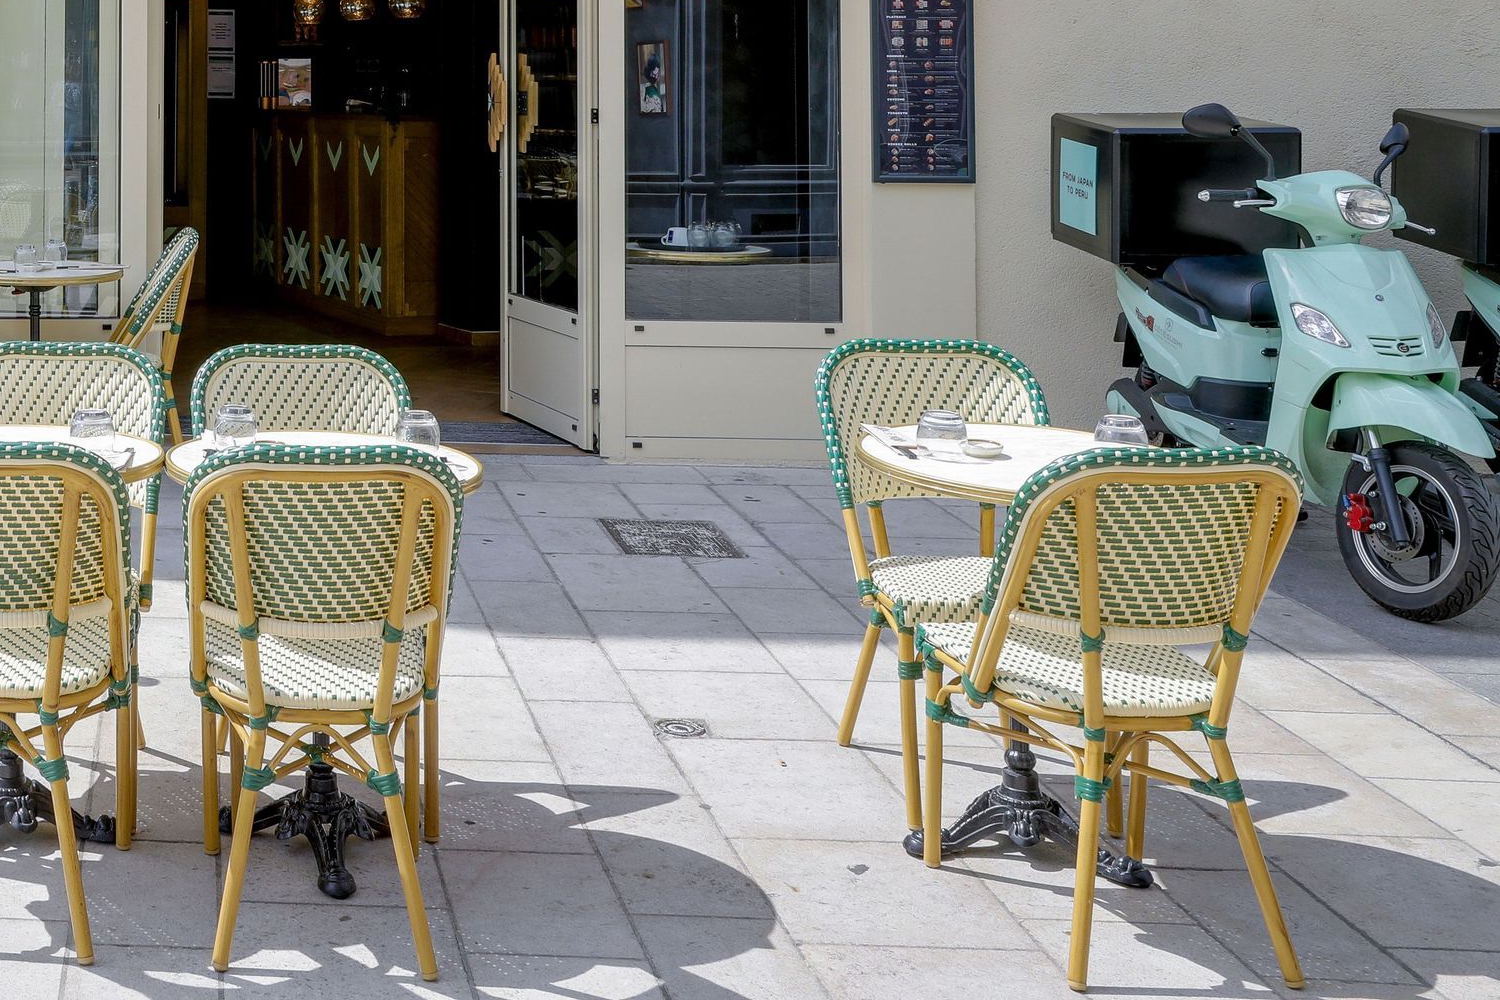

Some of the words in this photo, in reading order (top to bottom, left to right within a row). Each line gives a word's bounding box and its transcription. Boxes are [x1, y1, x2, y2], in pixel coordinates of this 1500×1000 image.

[1062, 171, 1076, 183] FROM
[1077, 177, 1094, 188] JAPAN
[1067, 185, 1073, 195] TO
[1075, 188, 1089, 200] PERU
